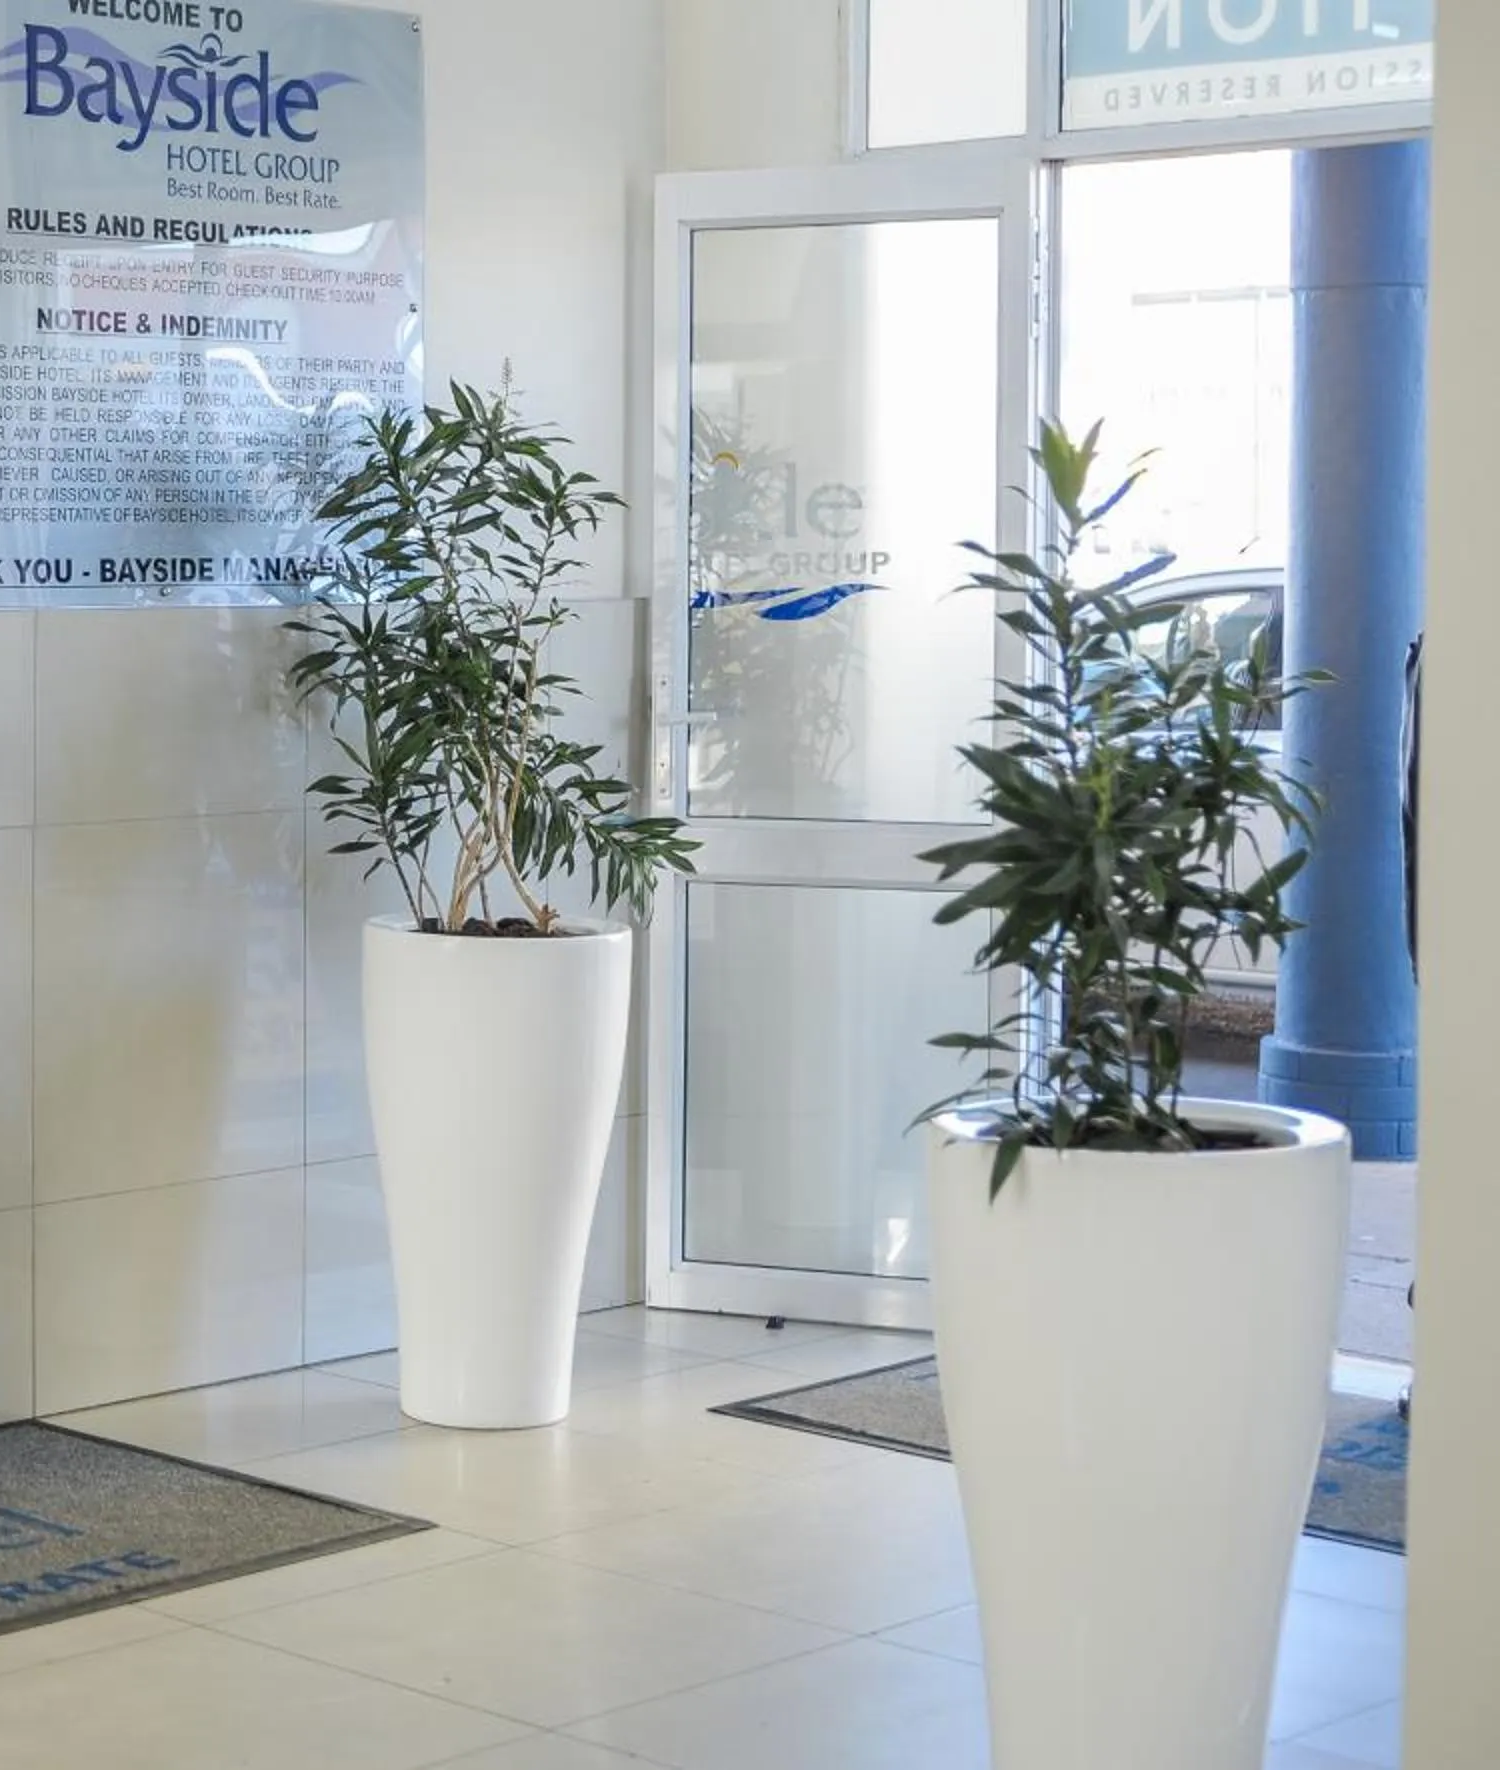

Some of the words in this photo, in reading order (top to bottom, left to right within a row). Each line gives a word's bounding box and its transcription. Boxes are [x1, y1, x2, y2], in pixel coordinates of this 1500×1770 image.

[67, 0, 200, 27] WELCOME
[209, 7, 243, 33] TO
[23, 23, 319, 151] Bayside
[166, 144, 247, 177] HOTEL
[254, 152, 340, 184] GROUP
[166, 178, 202, 200] Best
[207, 182, 260, 206] Room.
[264, 185, 299, 207] Best
[303, 189, 342, 210] Rate.
[7, 207, 87, 236] RULES
[94, 215, 148, 240] AND
[81, 273, 147, 292] CHEQUES
[150, 278, 220, 298] ACCEPTED
[225, 282, 267, 300] CHECK
[152, 257, 195, 276] ENTRY
[201, 260, 228, 276] FOR
[233, 262, 276, 281] GUEST
[281, 267, 341, 285] SECURITY
[346, 272, 405, 291] PURPOSE
[36, 307, 127, 333] NOTICE
[135, 313, 152, 334] &
[161, 314, 289, 341] INDEMNITY
[11, 345, 93, 364] APPLICABLE
[100, 348, 117, 364] TO
[122, 349, 143, 365] ALL
[276, 357, 294, 372] OF
[297, 358, 333, 375] THEIR
[337, 360, 375, 376] PARTY
[379, 360, 405, 377] AND
[51, 386, 112, 404] BAYSIDE
[90, 368, 111, 385] ITS
[116, 369, 209, 388] MANAGEMENT
[212, 373, 239, 389] AND
[269, 374, 318, 392] AGENTS
[321, 377, 378, 395] RESERVE
[381, 379, 406, 395] THE
[29, 406, 48, 422] BE
[55, 407, 91, 424] HELD
[97, 408, 188, 426] RESPONSIBLE
[194, 411, 221, 426] FOR
[227, 412, 252, 428] ANY
[13, 427, 42, 443] ANY
[49, 427, 98, 444] OTHER
[105, 428, 155, 444] CLAIMS
[161, 430, 189, 446] FOR
[117, 448, 147, 464] THAT
[152, 449, 192, 466] ARISE
[195, 450, 232, 466] FROM
[115, 467, 134, 483] OR
[139, 468, 192, 485] ARISING
[195, 469, 221, 485] OUT
[225, 470, 244, 485] OF
[247, 470, 272, 487] ANY
[9, 487, 30, 503] OR
[33, 487, 100, 504] OMISSION
[103, 488, 122, 503] OF
[125, 489, 150, 504] ANY
[155, 489, 210, 505] PERSON
[211, 490, 225, 505] IN
[227, 490, 253, 505] THE
[113, 509, 131, 525] OF
[133, 508, 189, 525] BAYSIDE
[236, 509, 256, 525] ITS
[13, 557, 74, 584] YOU
[100, 556, 214, 584] BAYSIDE
[767, 551, 892, 578] GROUP
